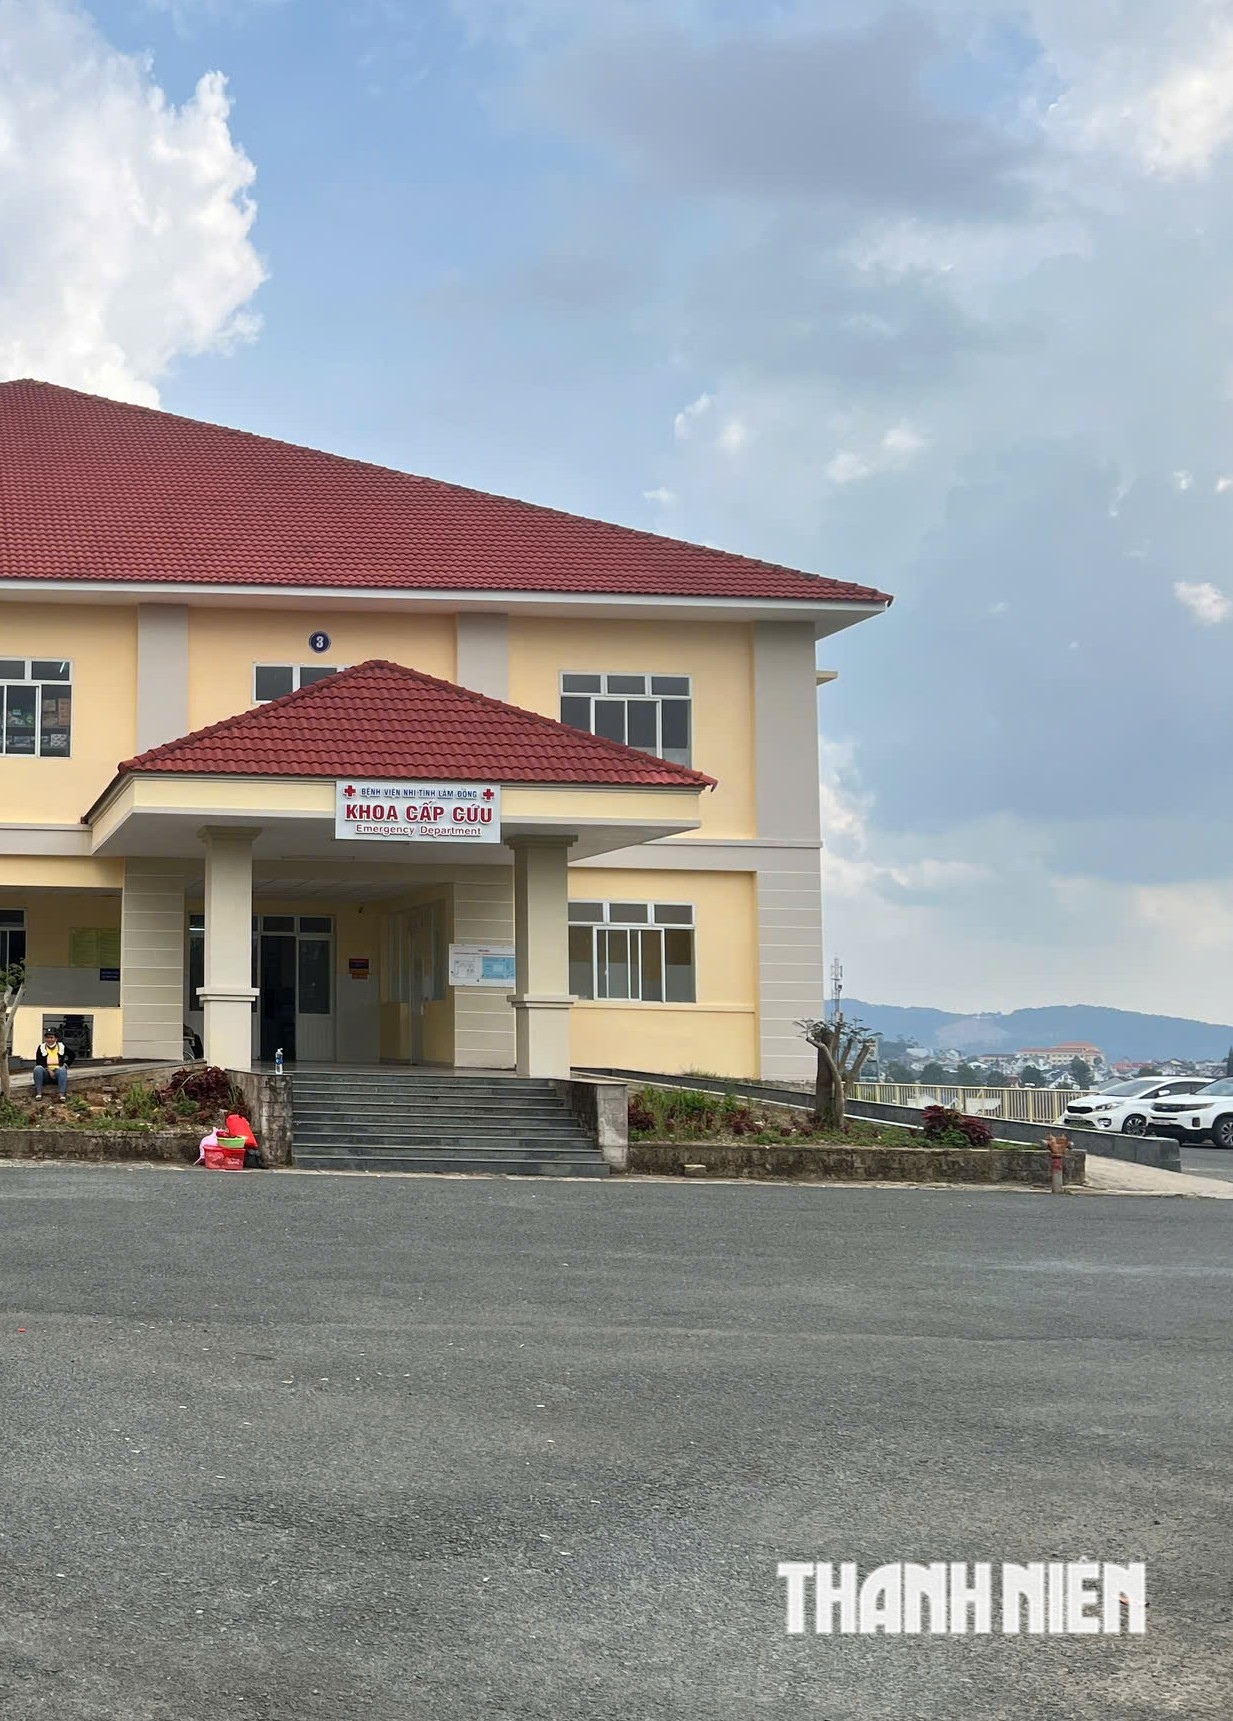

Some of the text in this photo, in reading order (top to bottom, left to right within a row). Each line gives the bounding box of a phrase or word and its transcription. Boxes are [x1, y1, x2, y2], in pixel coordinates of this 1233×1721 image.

[316, 636, 324, 648] 3
[361, 787, 381, 797] BỆNH
[384, 787, 401, 797] VIỆN
[404, 788, 416, 796] NHI
[346, 801, 492, 822] KHOA CẤP CỨU
[356, 824, 481, 836] Emergency Department
